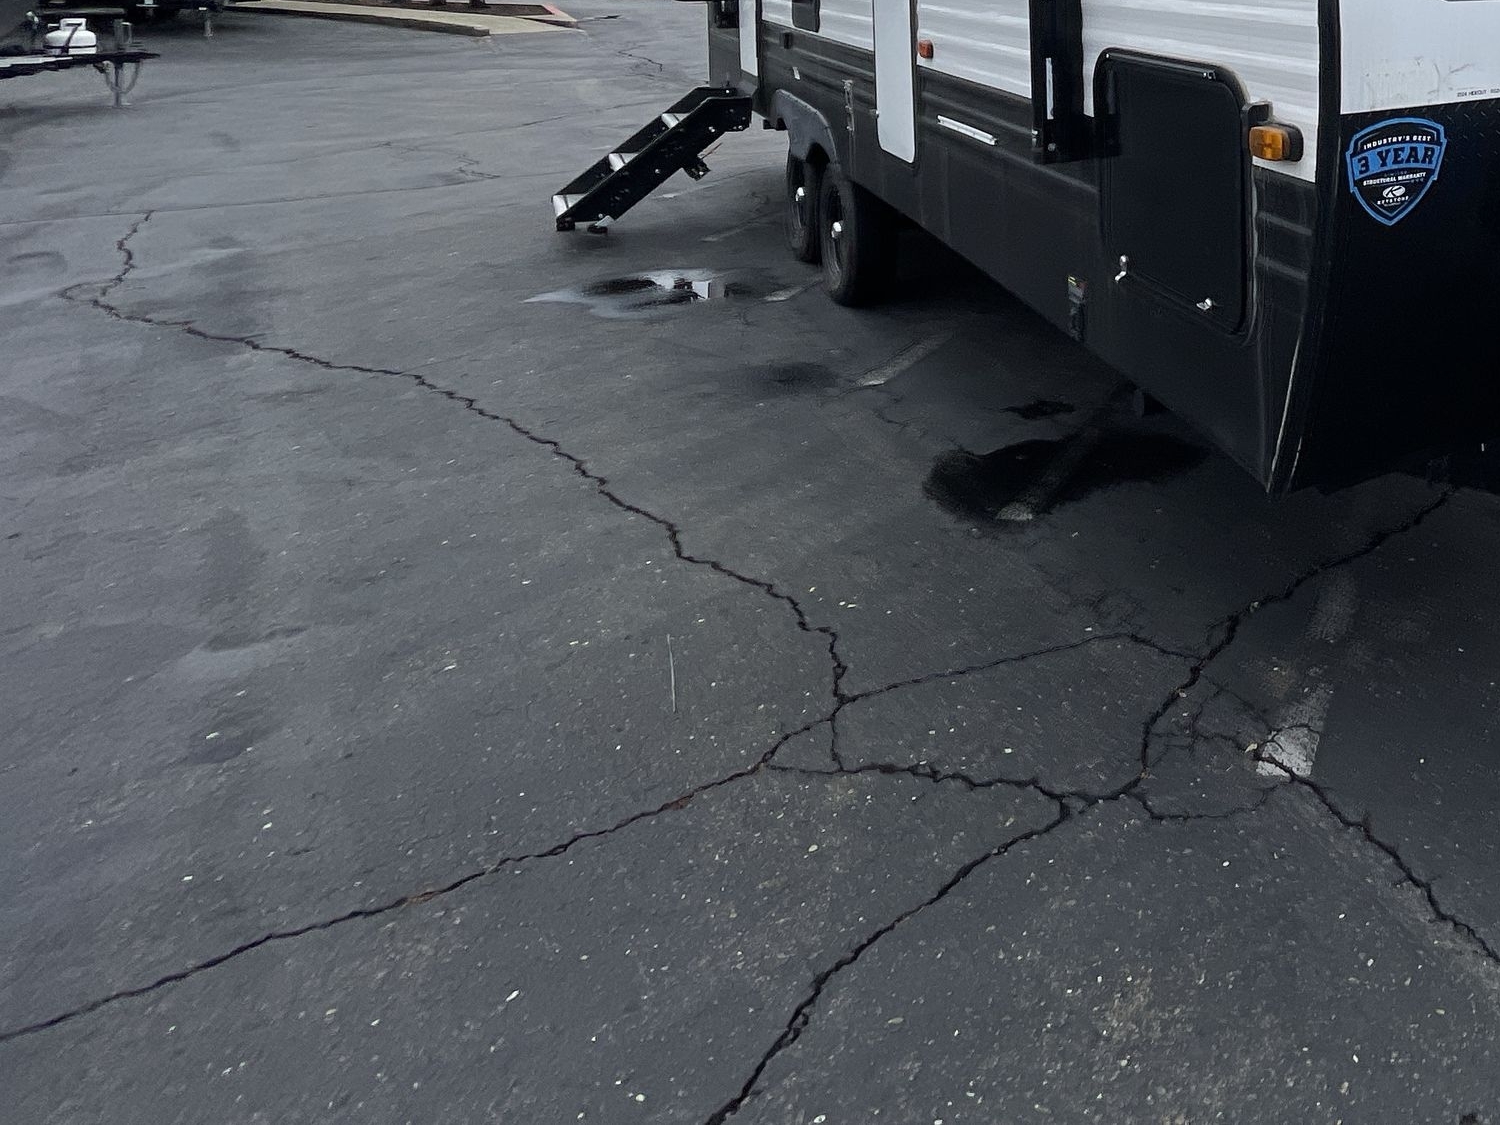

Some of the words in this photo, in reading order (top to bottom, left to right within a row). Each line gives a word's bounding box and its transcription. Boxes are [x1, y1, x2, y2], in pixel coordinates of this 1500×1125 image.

[1363, 135, 1410, 150] INDUSTRY'S
[1357, 155, 1370, 175] 3
[1376, 146, 1436, 167] YEAR
